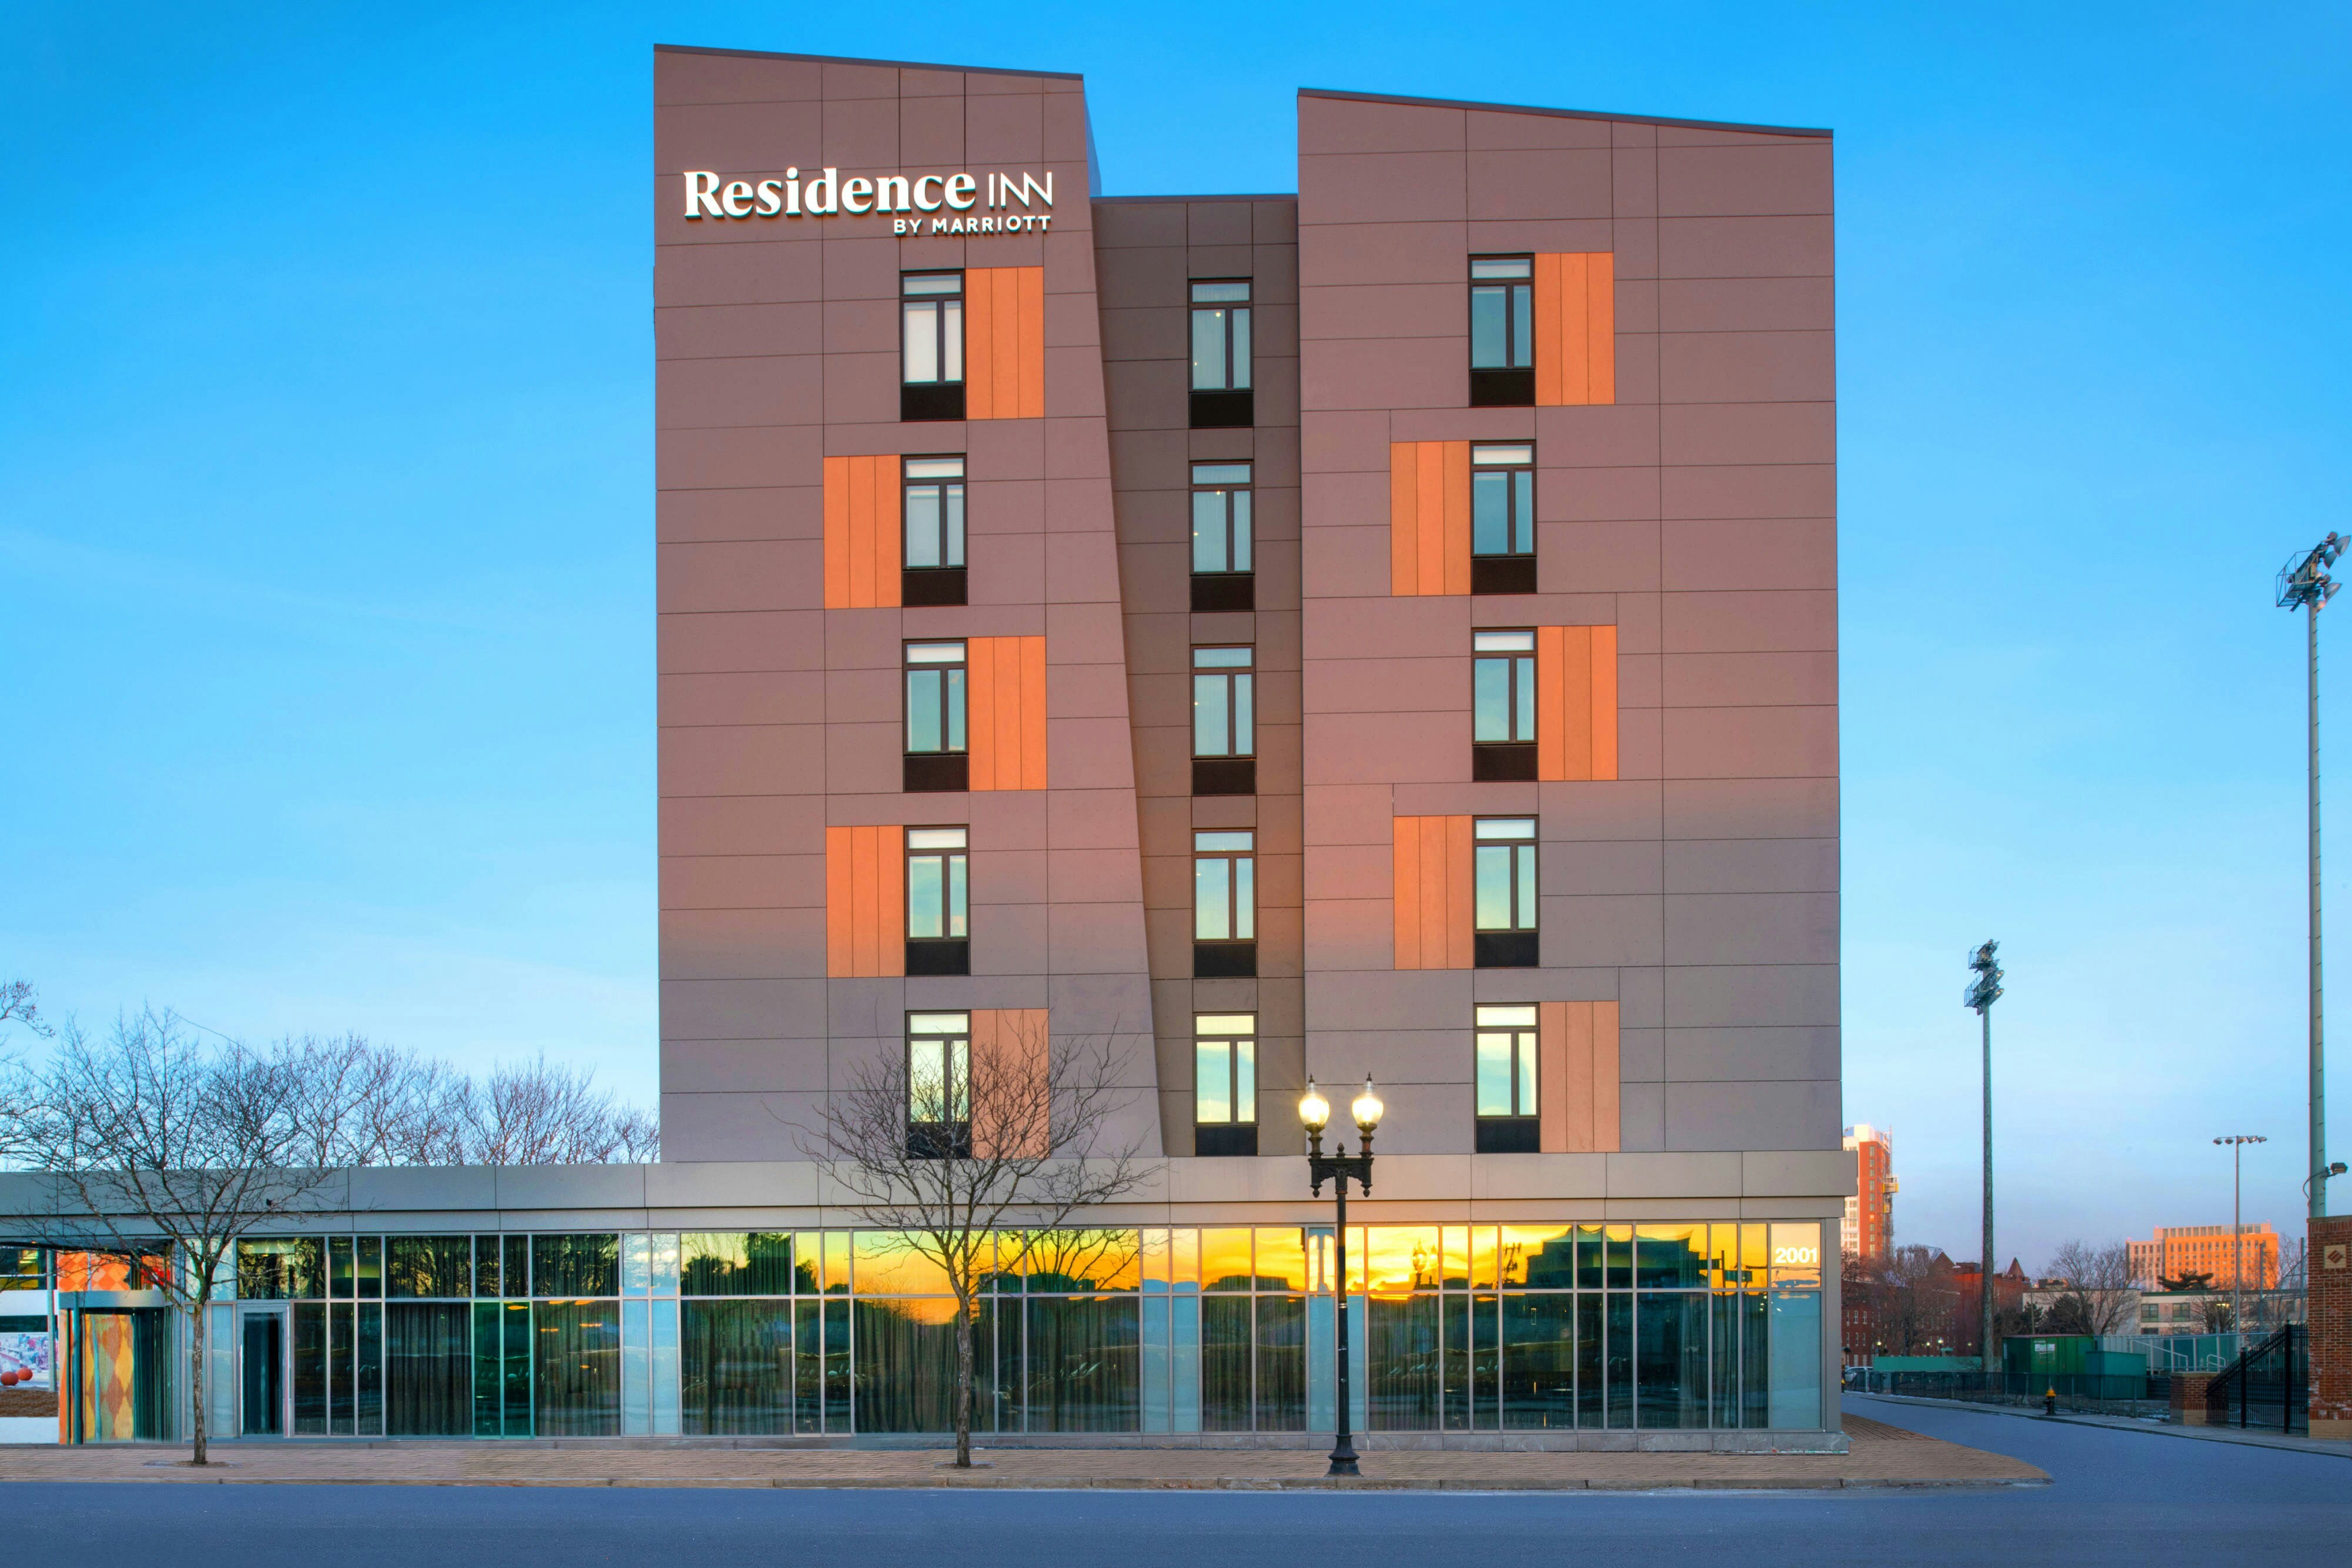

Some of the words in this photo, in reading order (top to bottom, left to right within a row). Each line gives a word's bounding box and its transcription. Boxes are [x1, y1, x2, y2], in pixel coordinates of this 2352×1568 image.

[683, 167, 975, 218] Residence
[988, 172, 1053, 210] INN
[894, 218, 923, 234] BY
[933, 215, 1051, 233] MARRIOTT
[1775, 1247, 1818, 1263] 2001
